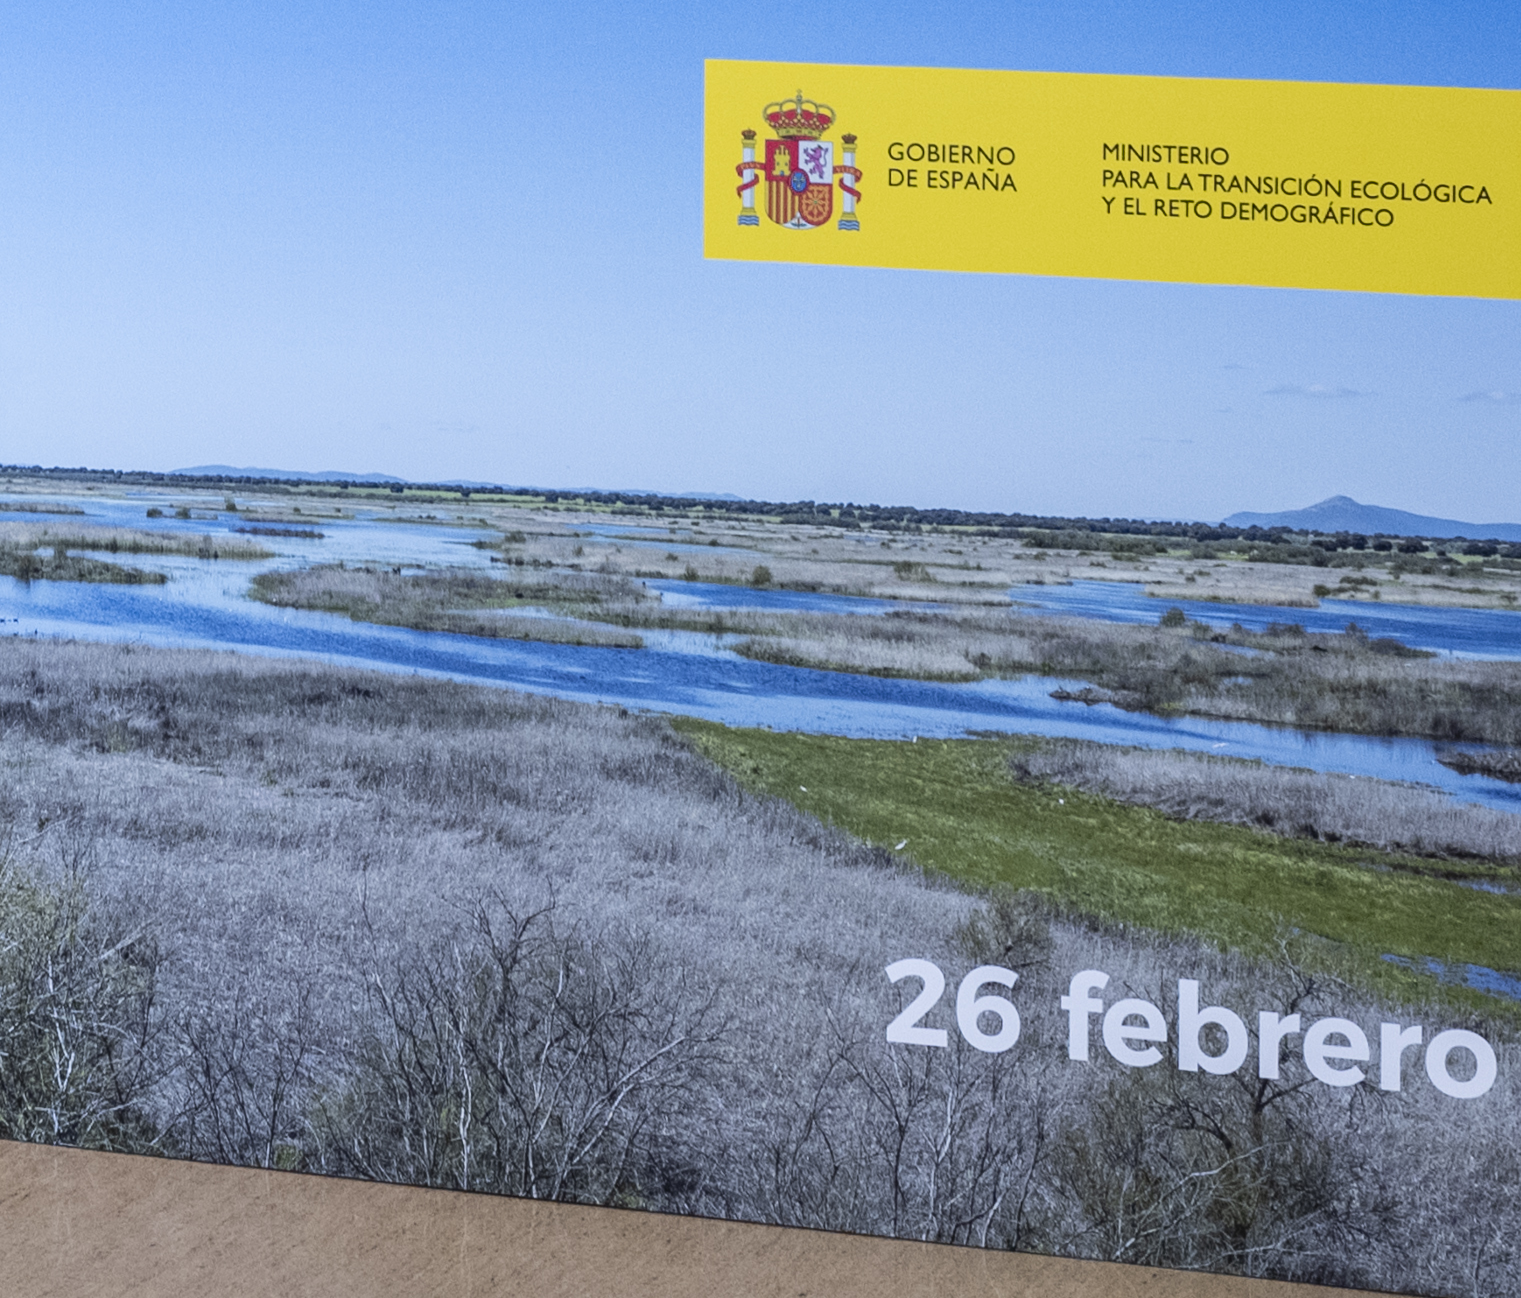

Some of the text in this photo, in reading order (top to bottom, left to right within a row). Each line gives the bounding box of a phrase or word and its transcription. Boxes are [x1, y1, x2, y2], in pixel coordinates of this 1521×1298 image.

[888, 142, 1015, 166] GOBIERNO
[1103, 143, 1229, 166] MINISTERIO
[888, 168, 1017, 192] DE ESPAÑA
[1103, 169, 1492, 205] PARA LA TRANSICIÓN ECOLÓGICA
[1102, 196, 1394, 227] Y EL RETO DEMOGRÁFICO
[885, 958, 1021, 1053] 26
[1061, 969, 1498, 1099] febrero
